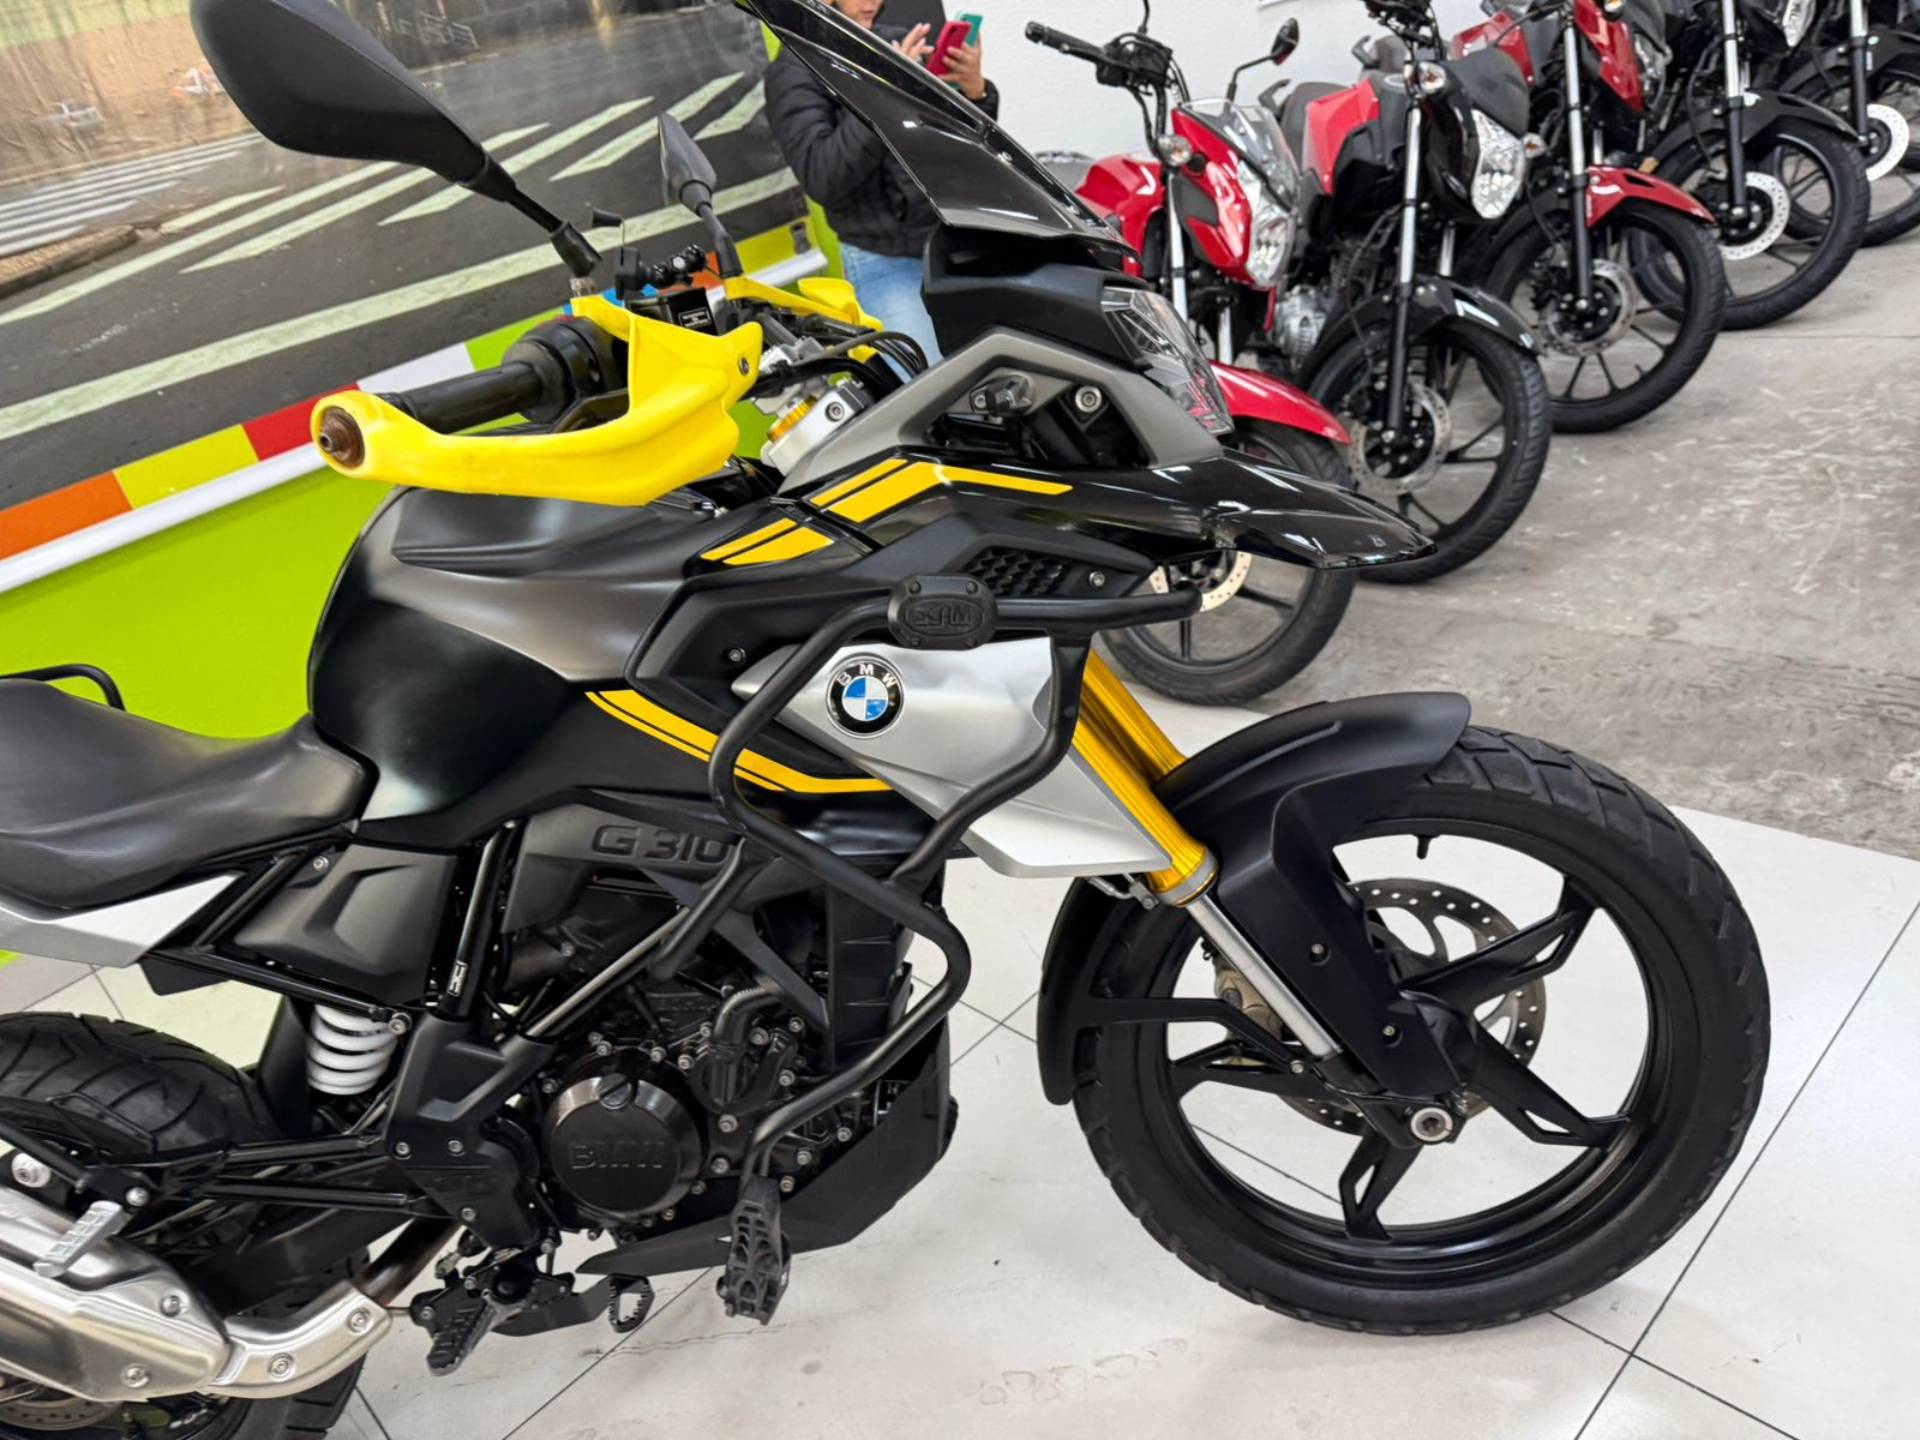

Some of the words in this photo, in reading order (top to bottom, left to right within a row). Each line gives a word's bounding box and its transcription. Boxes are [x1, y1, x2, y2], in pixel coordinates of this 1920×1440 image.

[836, 664, 899, 688] BMW
[593, 825, 639, 856] G
[645, 829, 728, 865] 310
[570, 1141, 664, 1168] BMW
